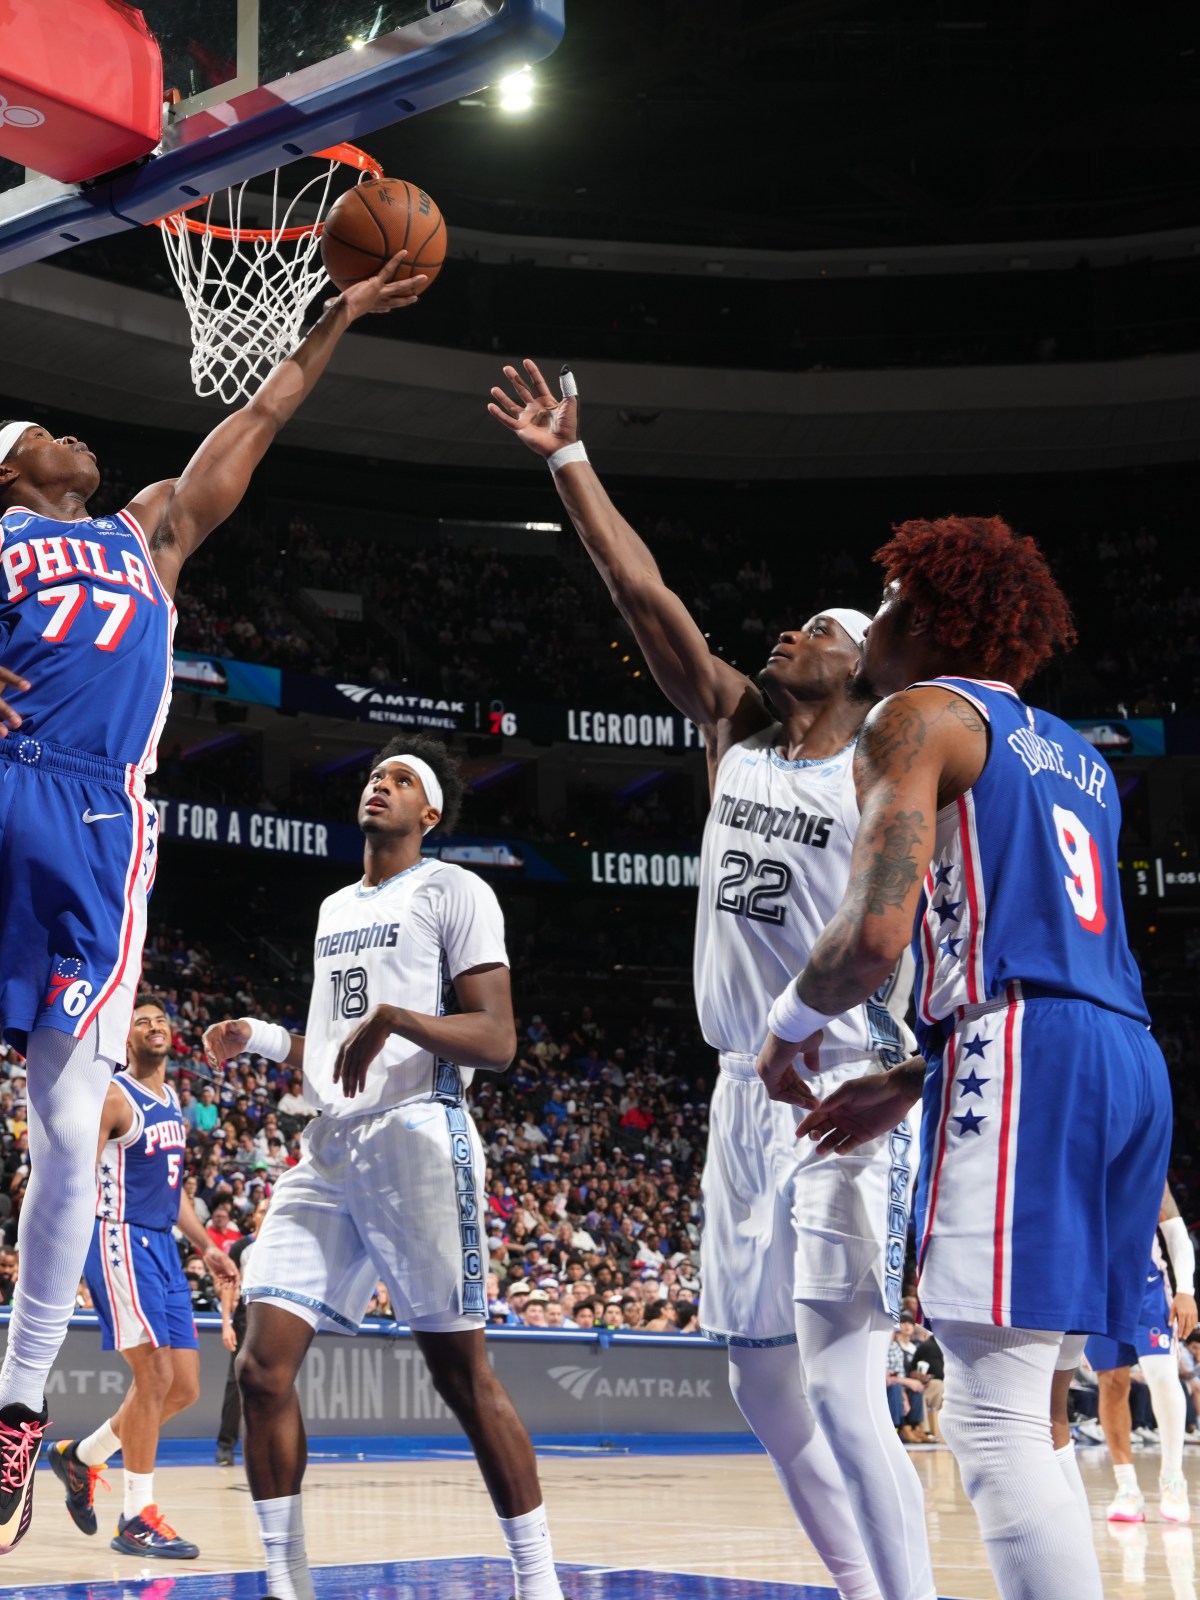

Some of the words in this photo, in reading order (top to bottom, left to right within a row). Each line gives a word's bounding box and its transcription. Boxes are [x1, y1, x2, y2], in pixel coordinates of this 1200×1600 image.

[0, 537, 158, 605] PHILA
[37, 584, 136, 652] 77
[369, 693, 465, 713] AMTRAK
[369, 710, 415, 724] RETRAIN
[417, 715, 456, 729] TRAVEL
[489, 711, 517, 736] 76
[568, 709, 674, 746] LEGROOM
[1074, 754, 1107, 808] JR.
[178, 803, 218, 841] FOR
[227, 811, 241, 844] A
[250, 814, 328, 856] CENTER
[592, 851, 701, 886] LEGROOM
[717, 849, 792, 926] 22
[1052, 803, 1107, 935] 9
[1165, 872, 1197, 884] 8:05
[46, 973, 93, 1017] 76
[331, 966, 368, 1021] 18
[167, 1154, 182, 1189] 5
[294, 1347, 384, 1419] RAIN
[596, 1377, 712, 1398] AMTRAK
